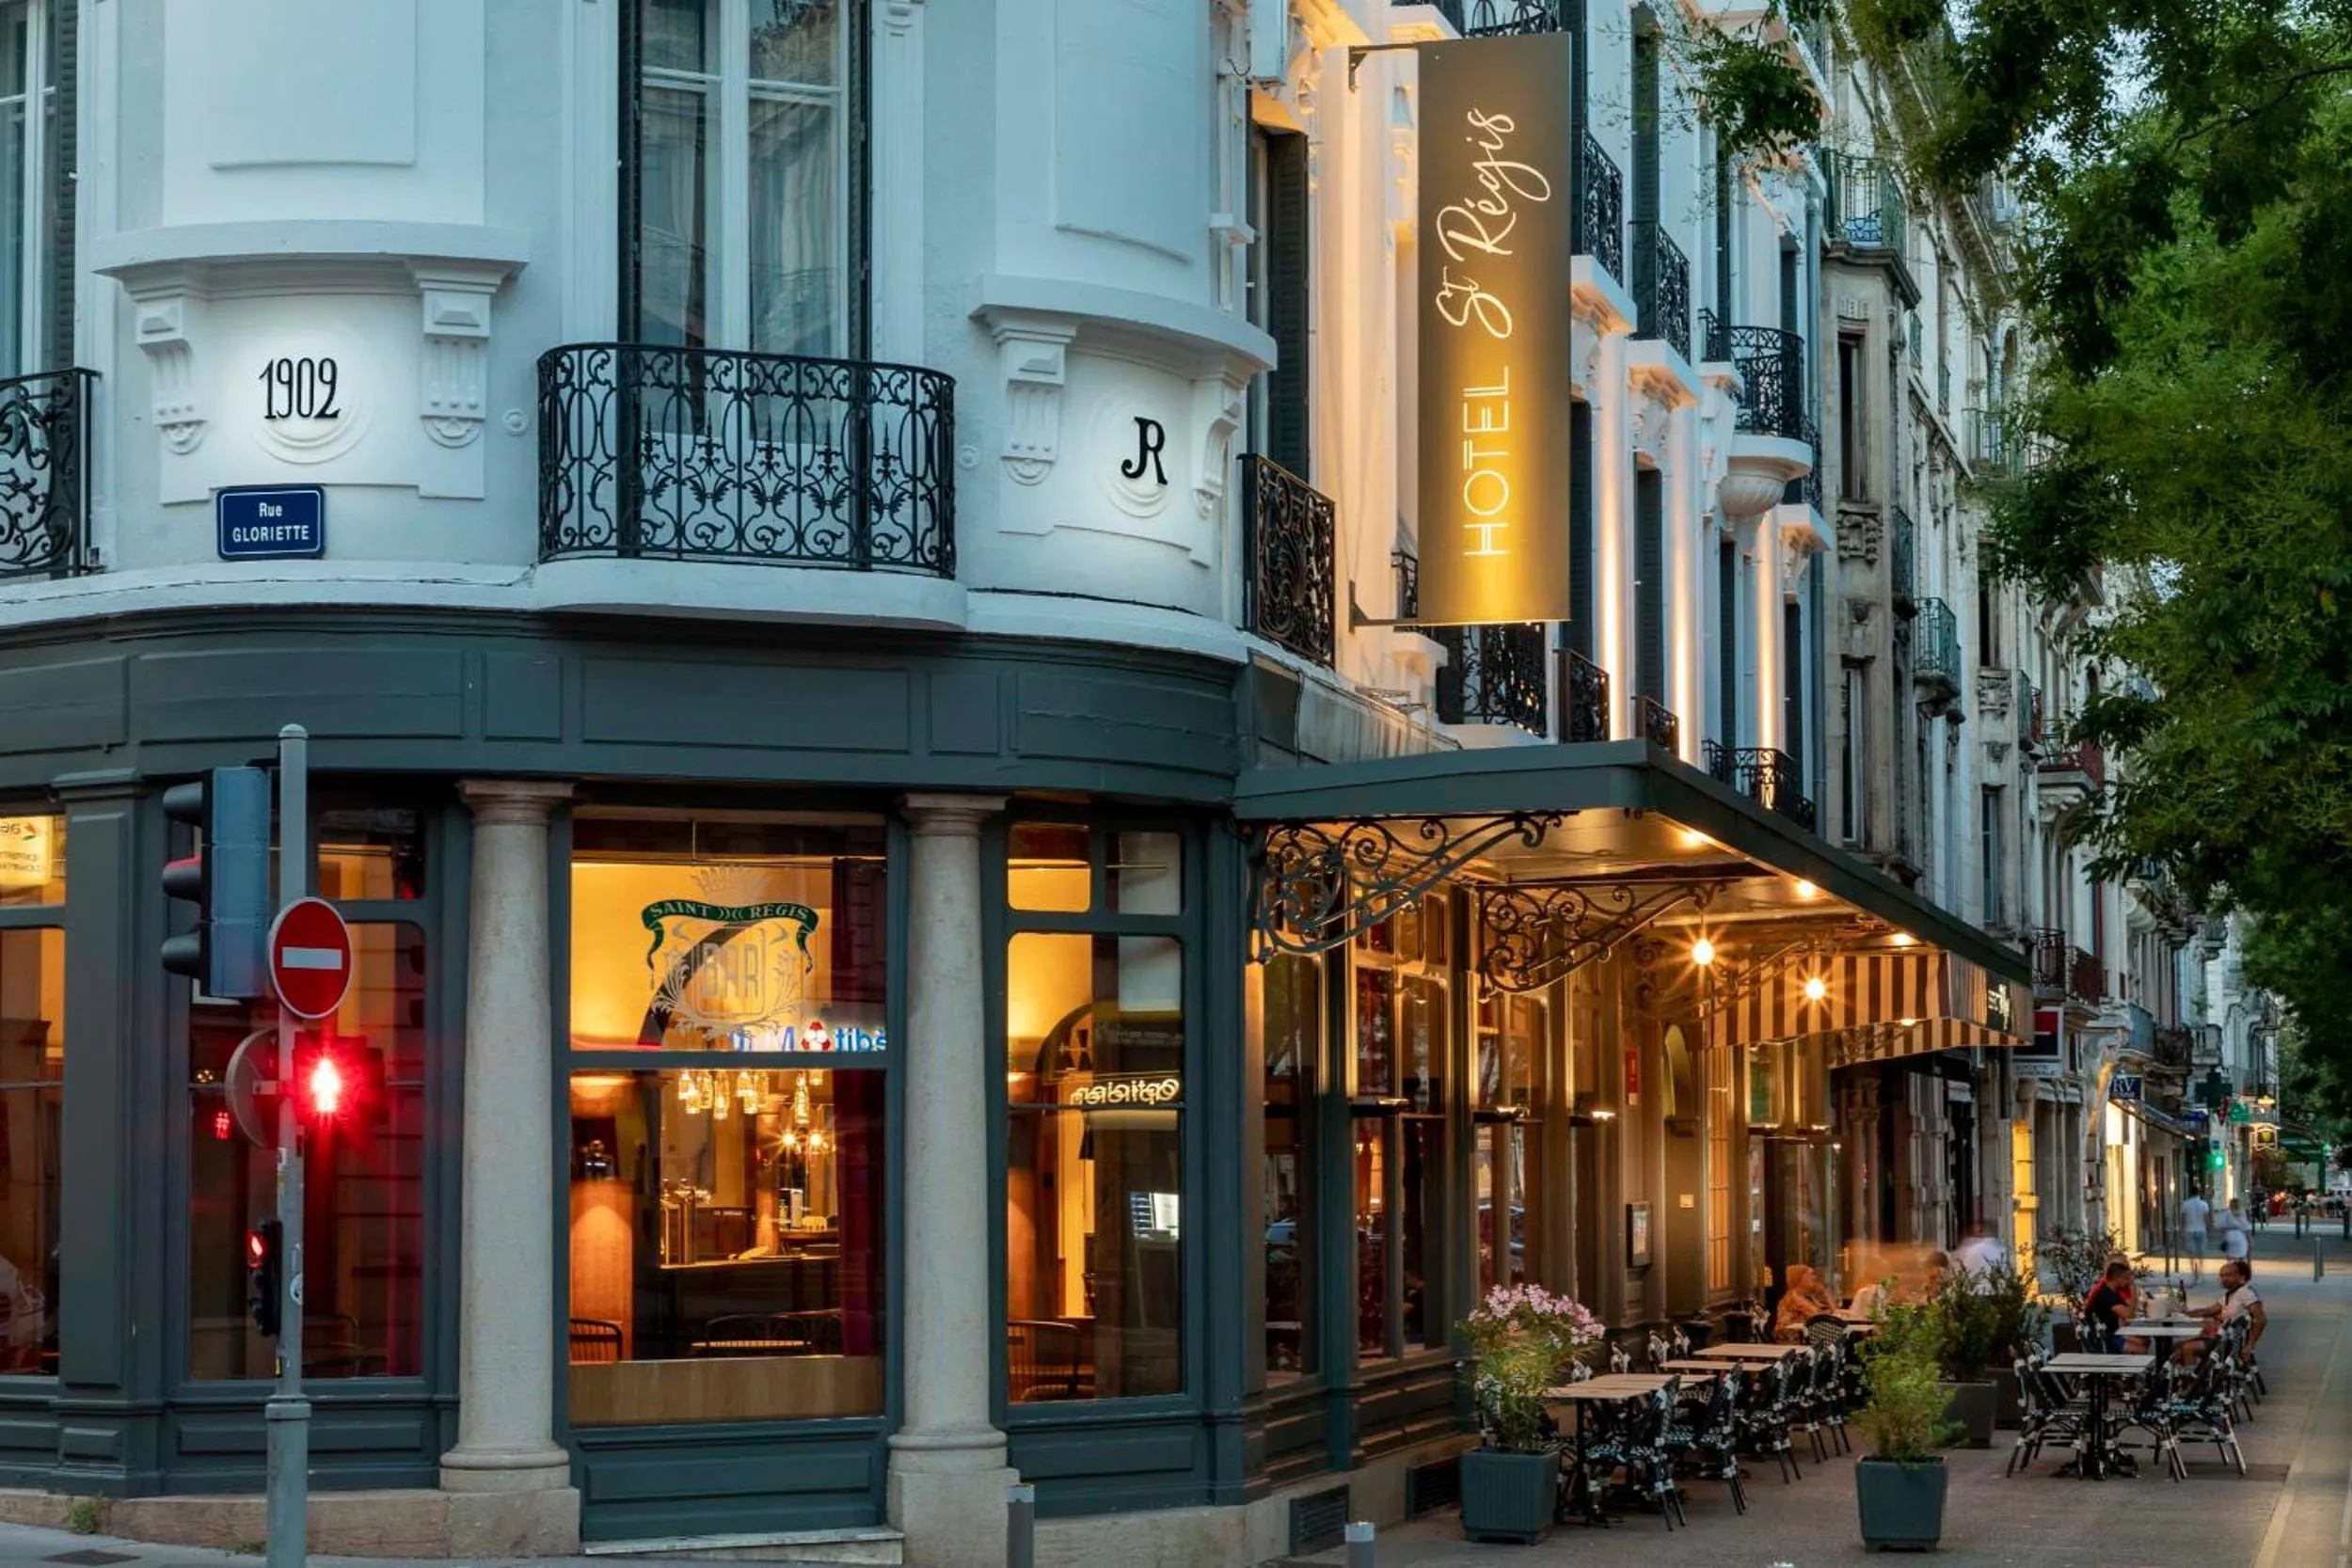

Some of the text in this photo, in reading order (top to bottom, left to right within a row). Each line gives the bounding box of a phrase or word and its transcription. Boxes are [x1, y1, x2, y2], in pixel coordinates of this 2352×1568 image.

[1436, 108, 1550, 555] HOTEL St Régis
[259, 357, 341, 419] 1902
[259, 501, 283, 517] Rue
[232, 524, 310, 543] GLORIETTE
[650, 900, 810, 921] SAINT REGIS
[701, 942, 759, 999] BAR
